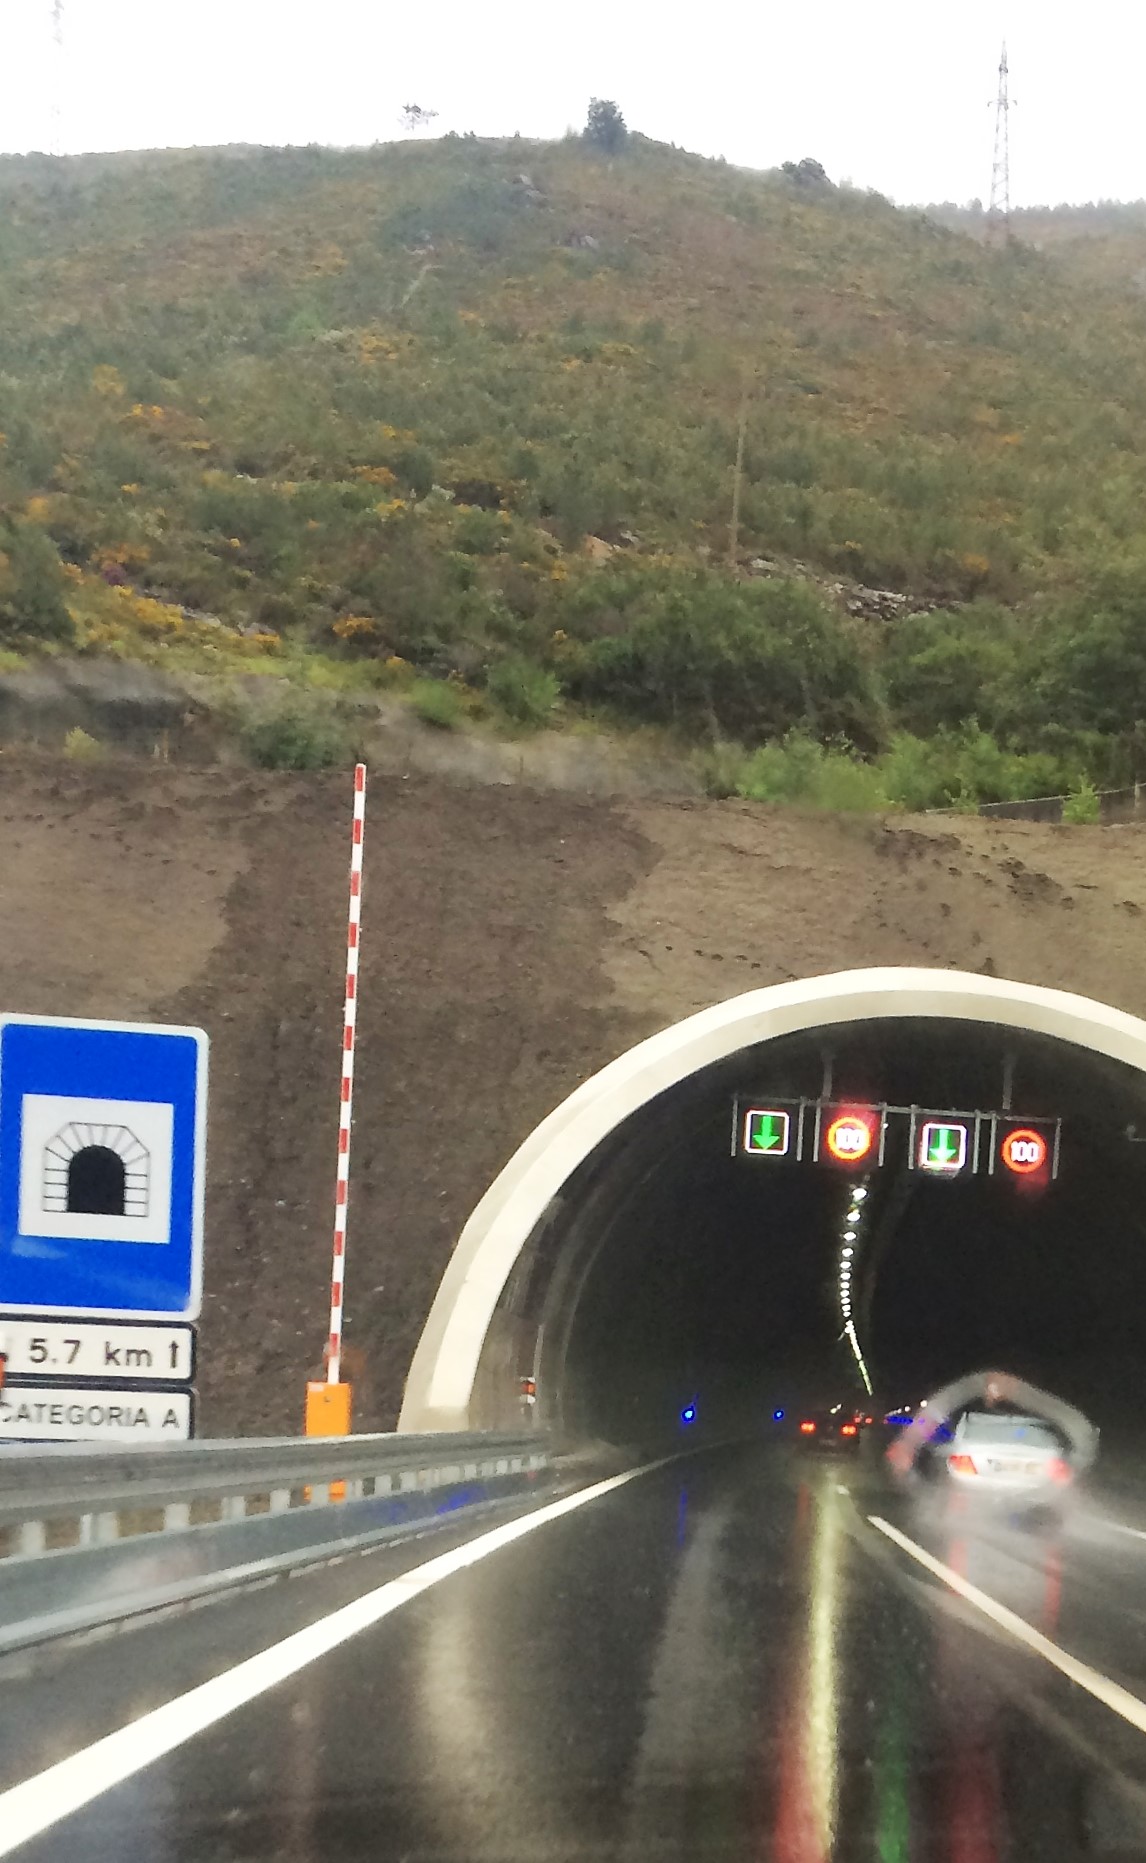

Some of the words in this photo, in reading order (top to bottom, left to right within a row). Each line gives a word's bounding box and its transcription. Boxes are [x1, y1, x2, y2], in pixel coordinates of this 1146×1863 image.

[835, 1127, 862, 1151] 100
[1010, 1140, 1040, 1163] 100
[30, 1338, 81, 1364] 5.7
[104, 1341, 153, 1367] km
[162, 1408, 180, 1429] A
